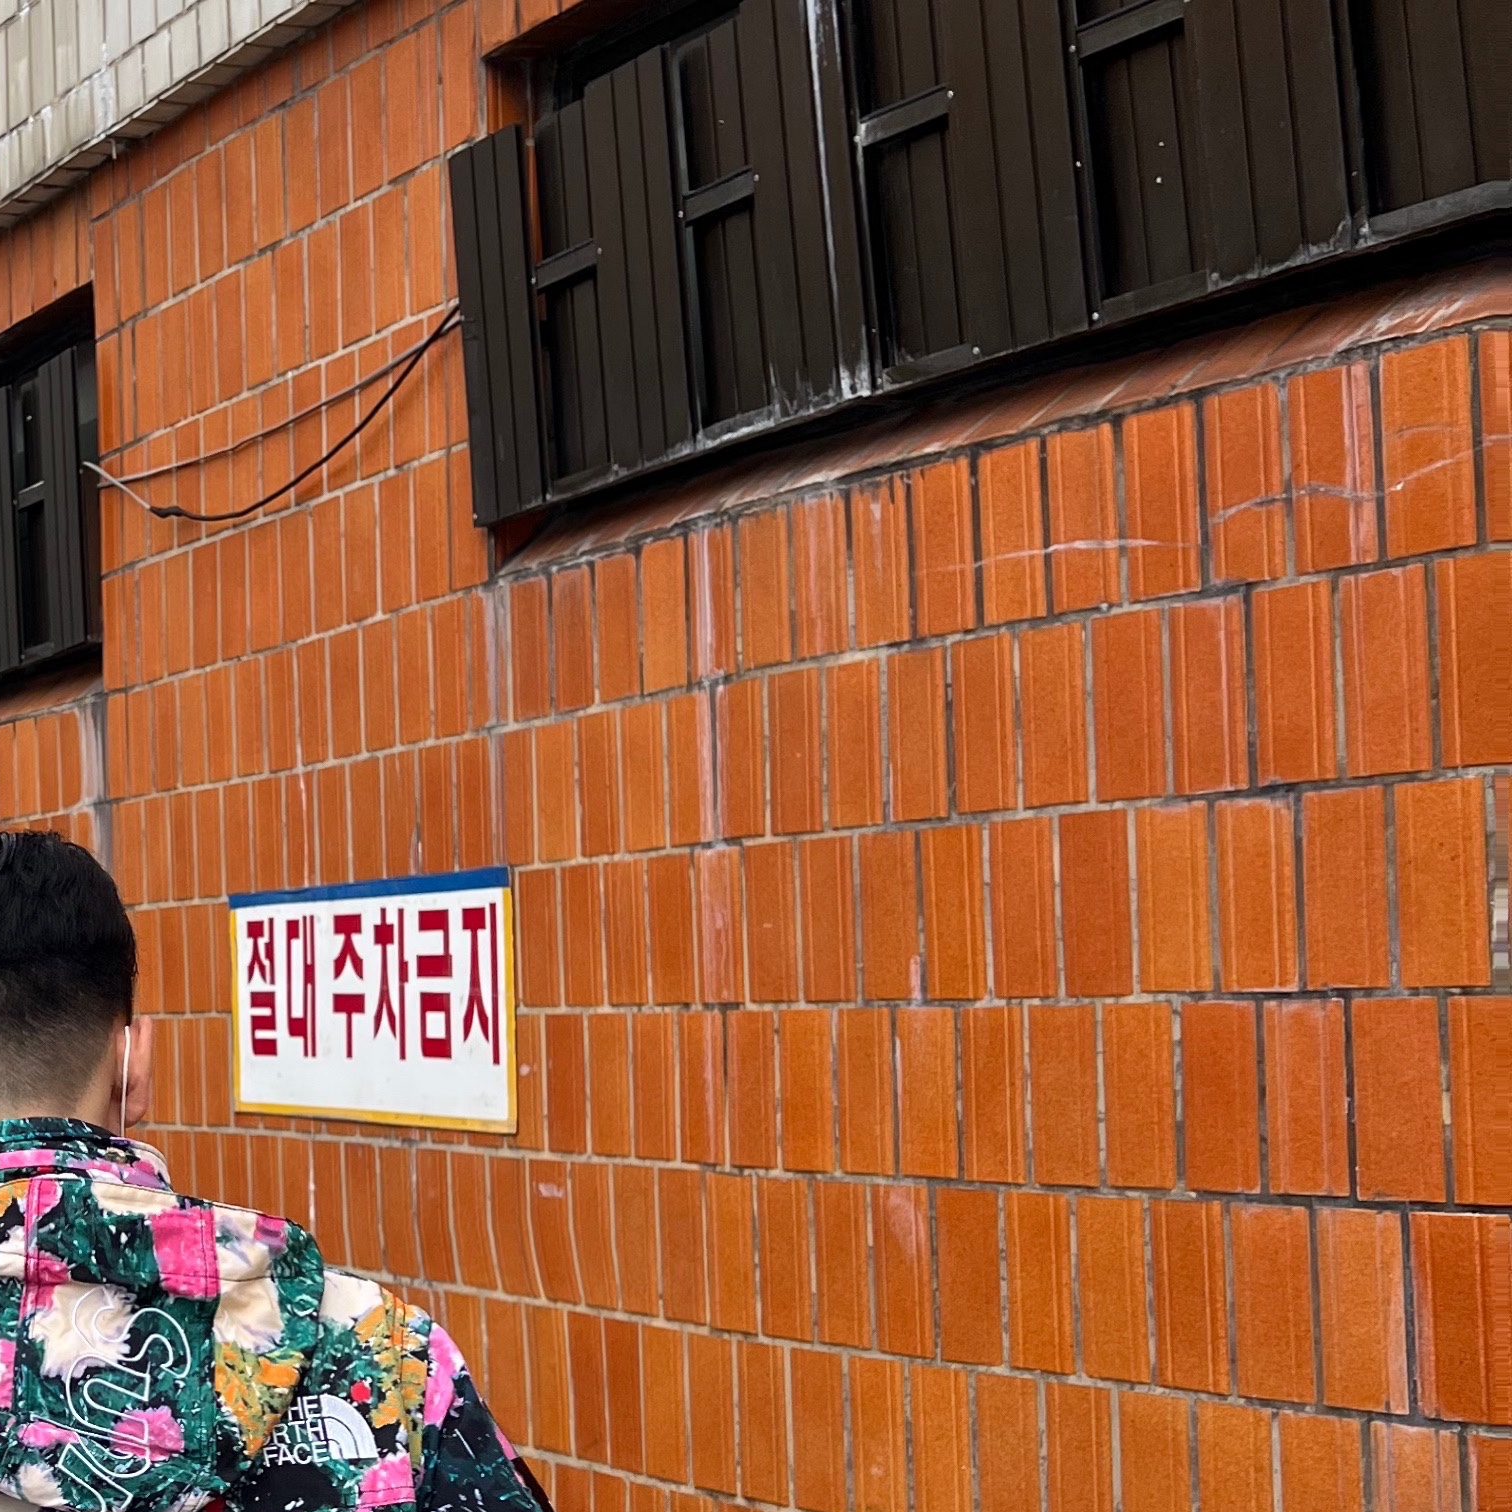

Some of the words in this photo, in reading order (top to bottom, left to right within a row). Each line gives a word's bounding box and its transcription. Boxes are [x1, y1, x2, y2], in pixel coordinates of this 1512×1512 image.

[289, 1393, 321, 1420] HE
[264, 1418, 325, 1447] RTH
[263, 1441, 331, 1468] FACE
